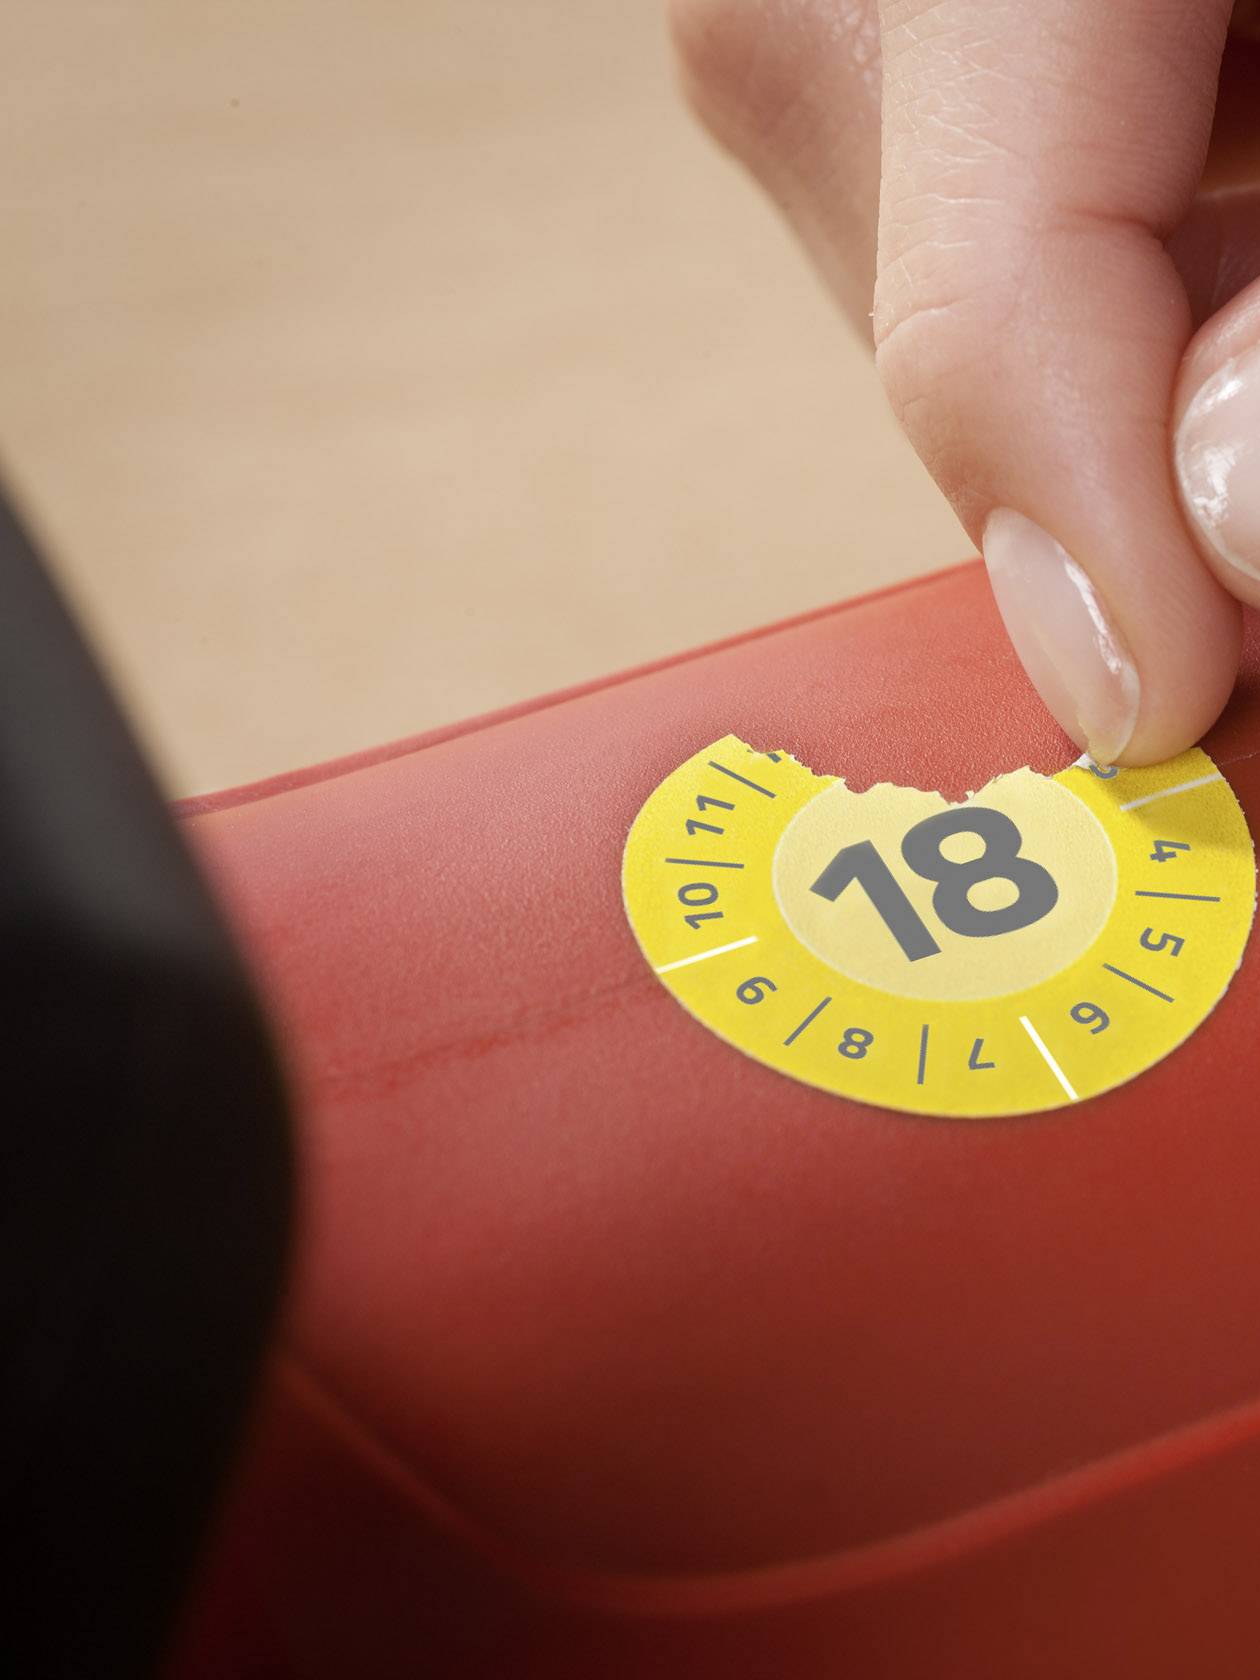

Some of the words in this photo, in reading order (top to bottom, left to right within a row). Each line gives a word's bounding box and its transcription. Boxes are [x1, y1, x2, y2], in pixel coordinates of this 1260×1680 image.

[685, 794, 735, 836] 11
[1150, 839, 1191, 863] 4
[809, 806, 1059, 963] 18
[677, 882, 724, 929] 10
[1139, 927, 1185, 957] 5
[735, 976, 777, 1006] 9
[1069, 1001, 1110, 1034] 6
[837, 1027, 874, 1060] 8
[968, 1038, 996, 1071] 7
